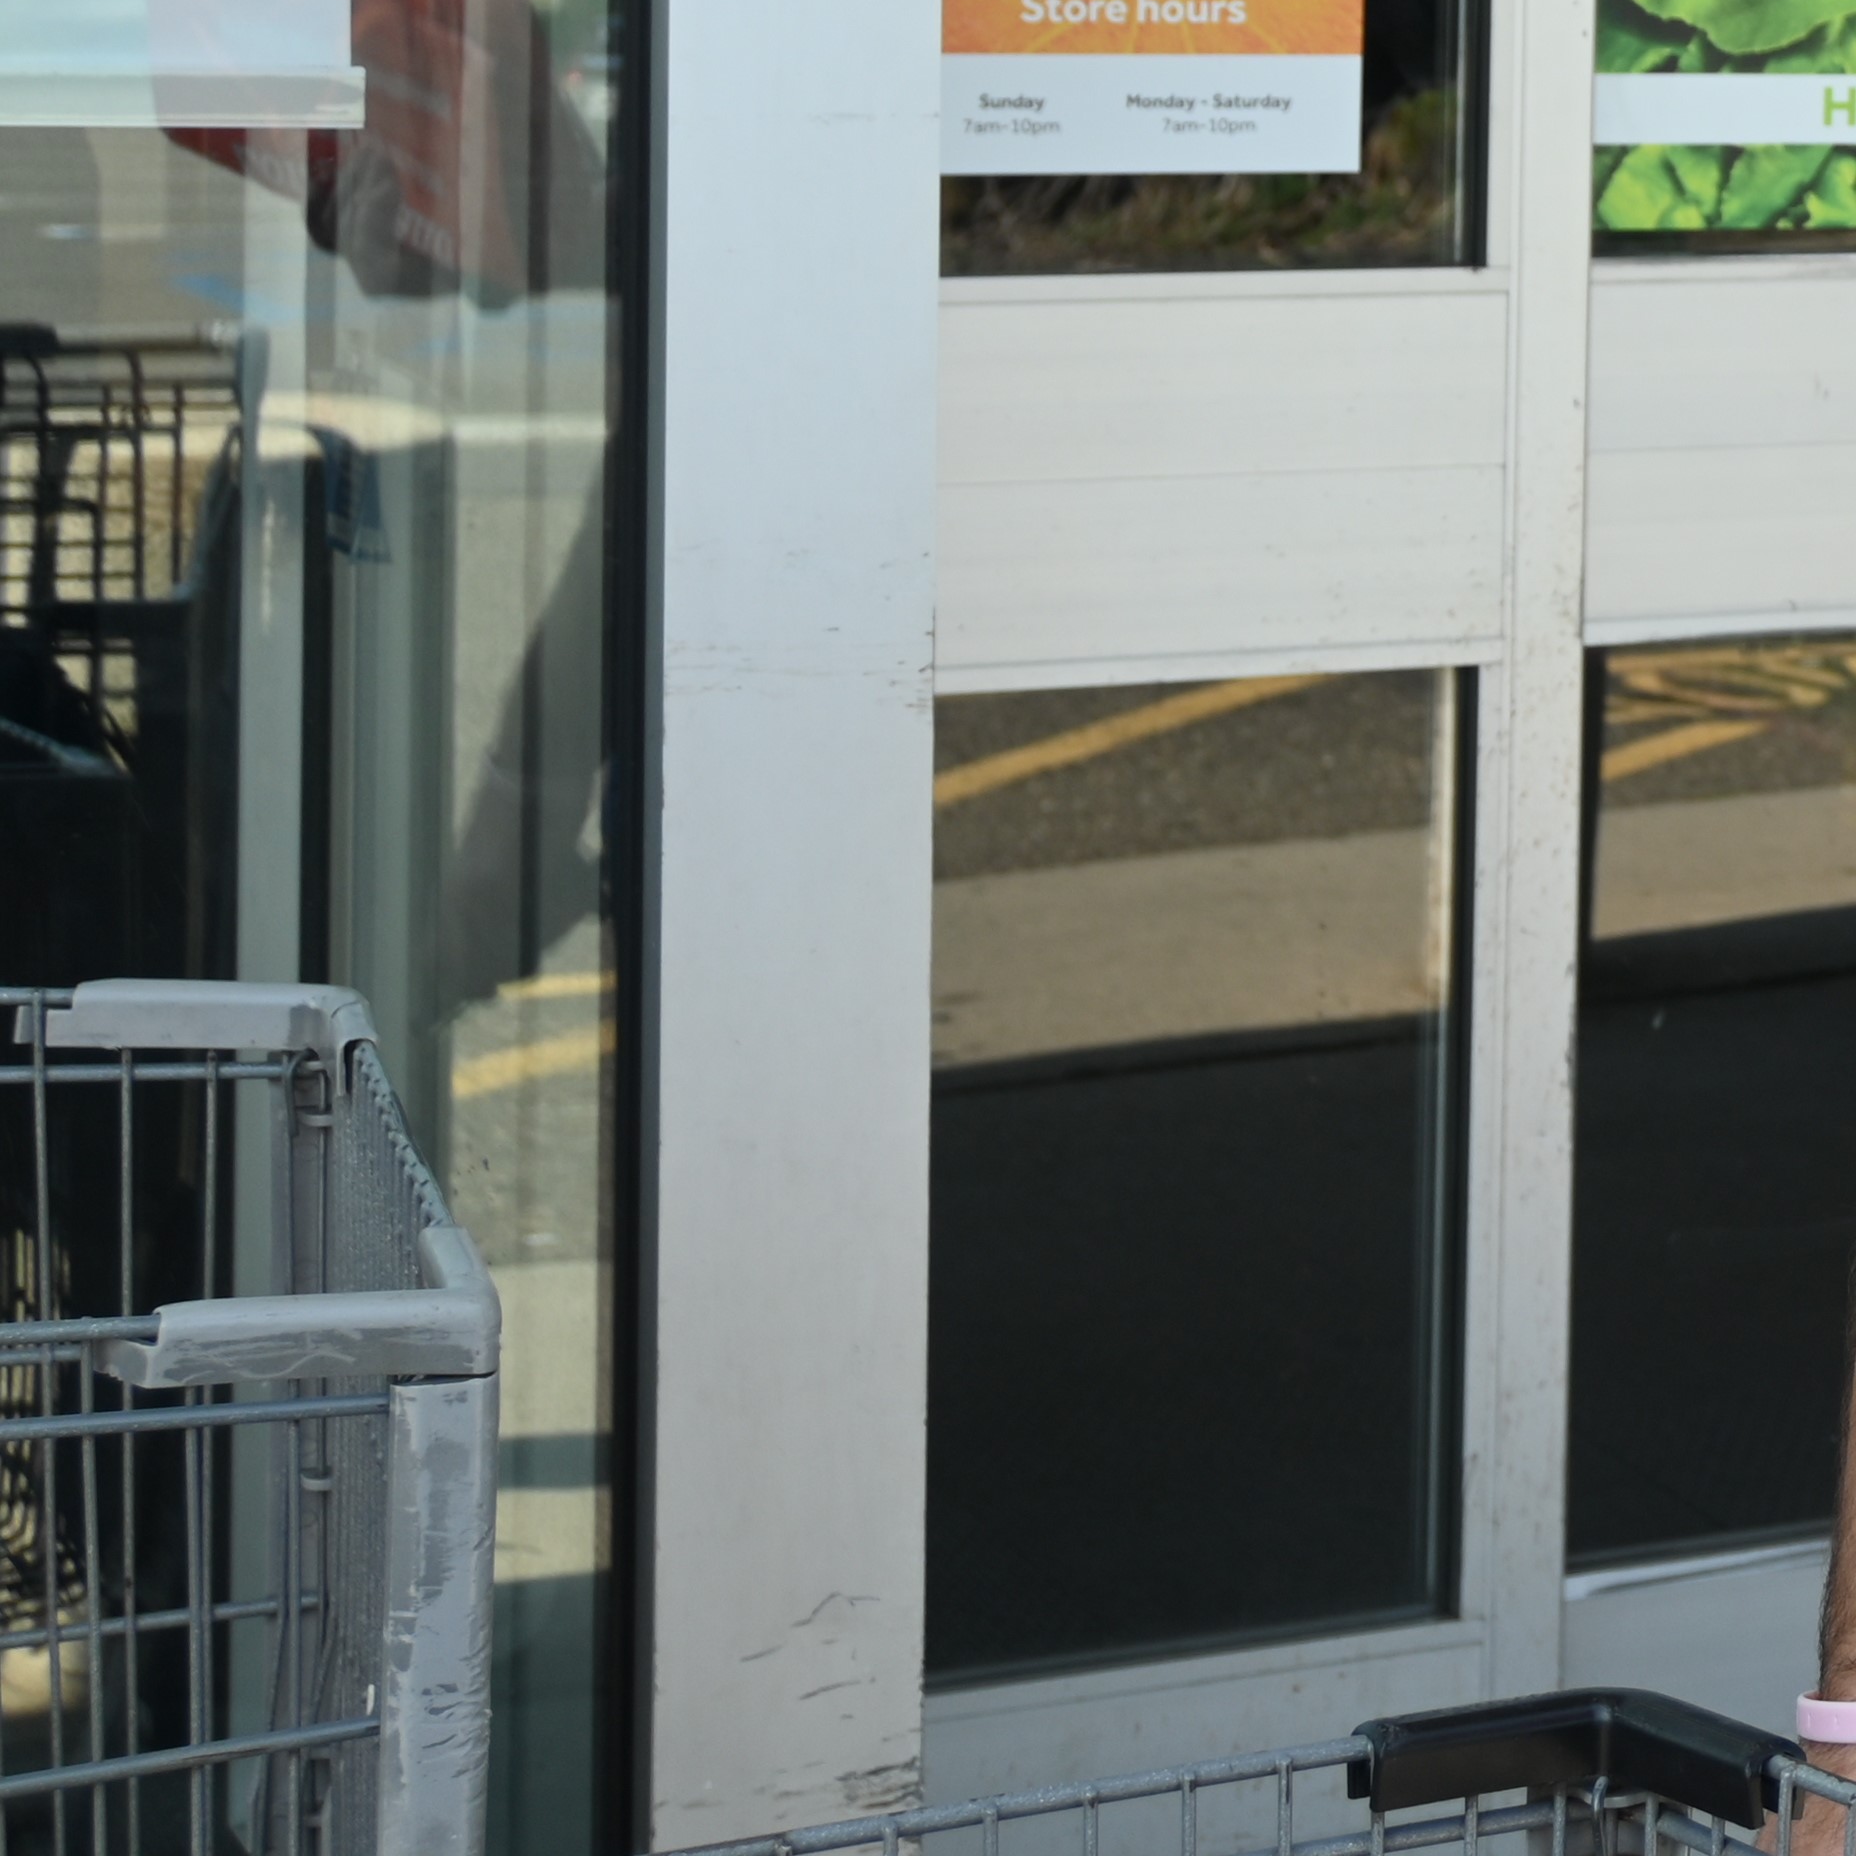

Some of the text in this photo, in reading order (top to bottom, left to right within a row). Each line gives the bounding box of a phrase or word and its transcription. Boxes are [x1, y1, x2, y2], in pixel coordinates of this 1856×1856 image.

[978, 93, 1045, 112] Sunday
[1126, 93, 1197, 113] Monday
[1212, 94, 1292, 113] Saturday
[962, 118, 1062, 136] 7am-10pm
[1162, 117, 1258, 135] 7am-10pm
